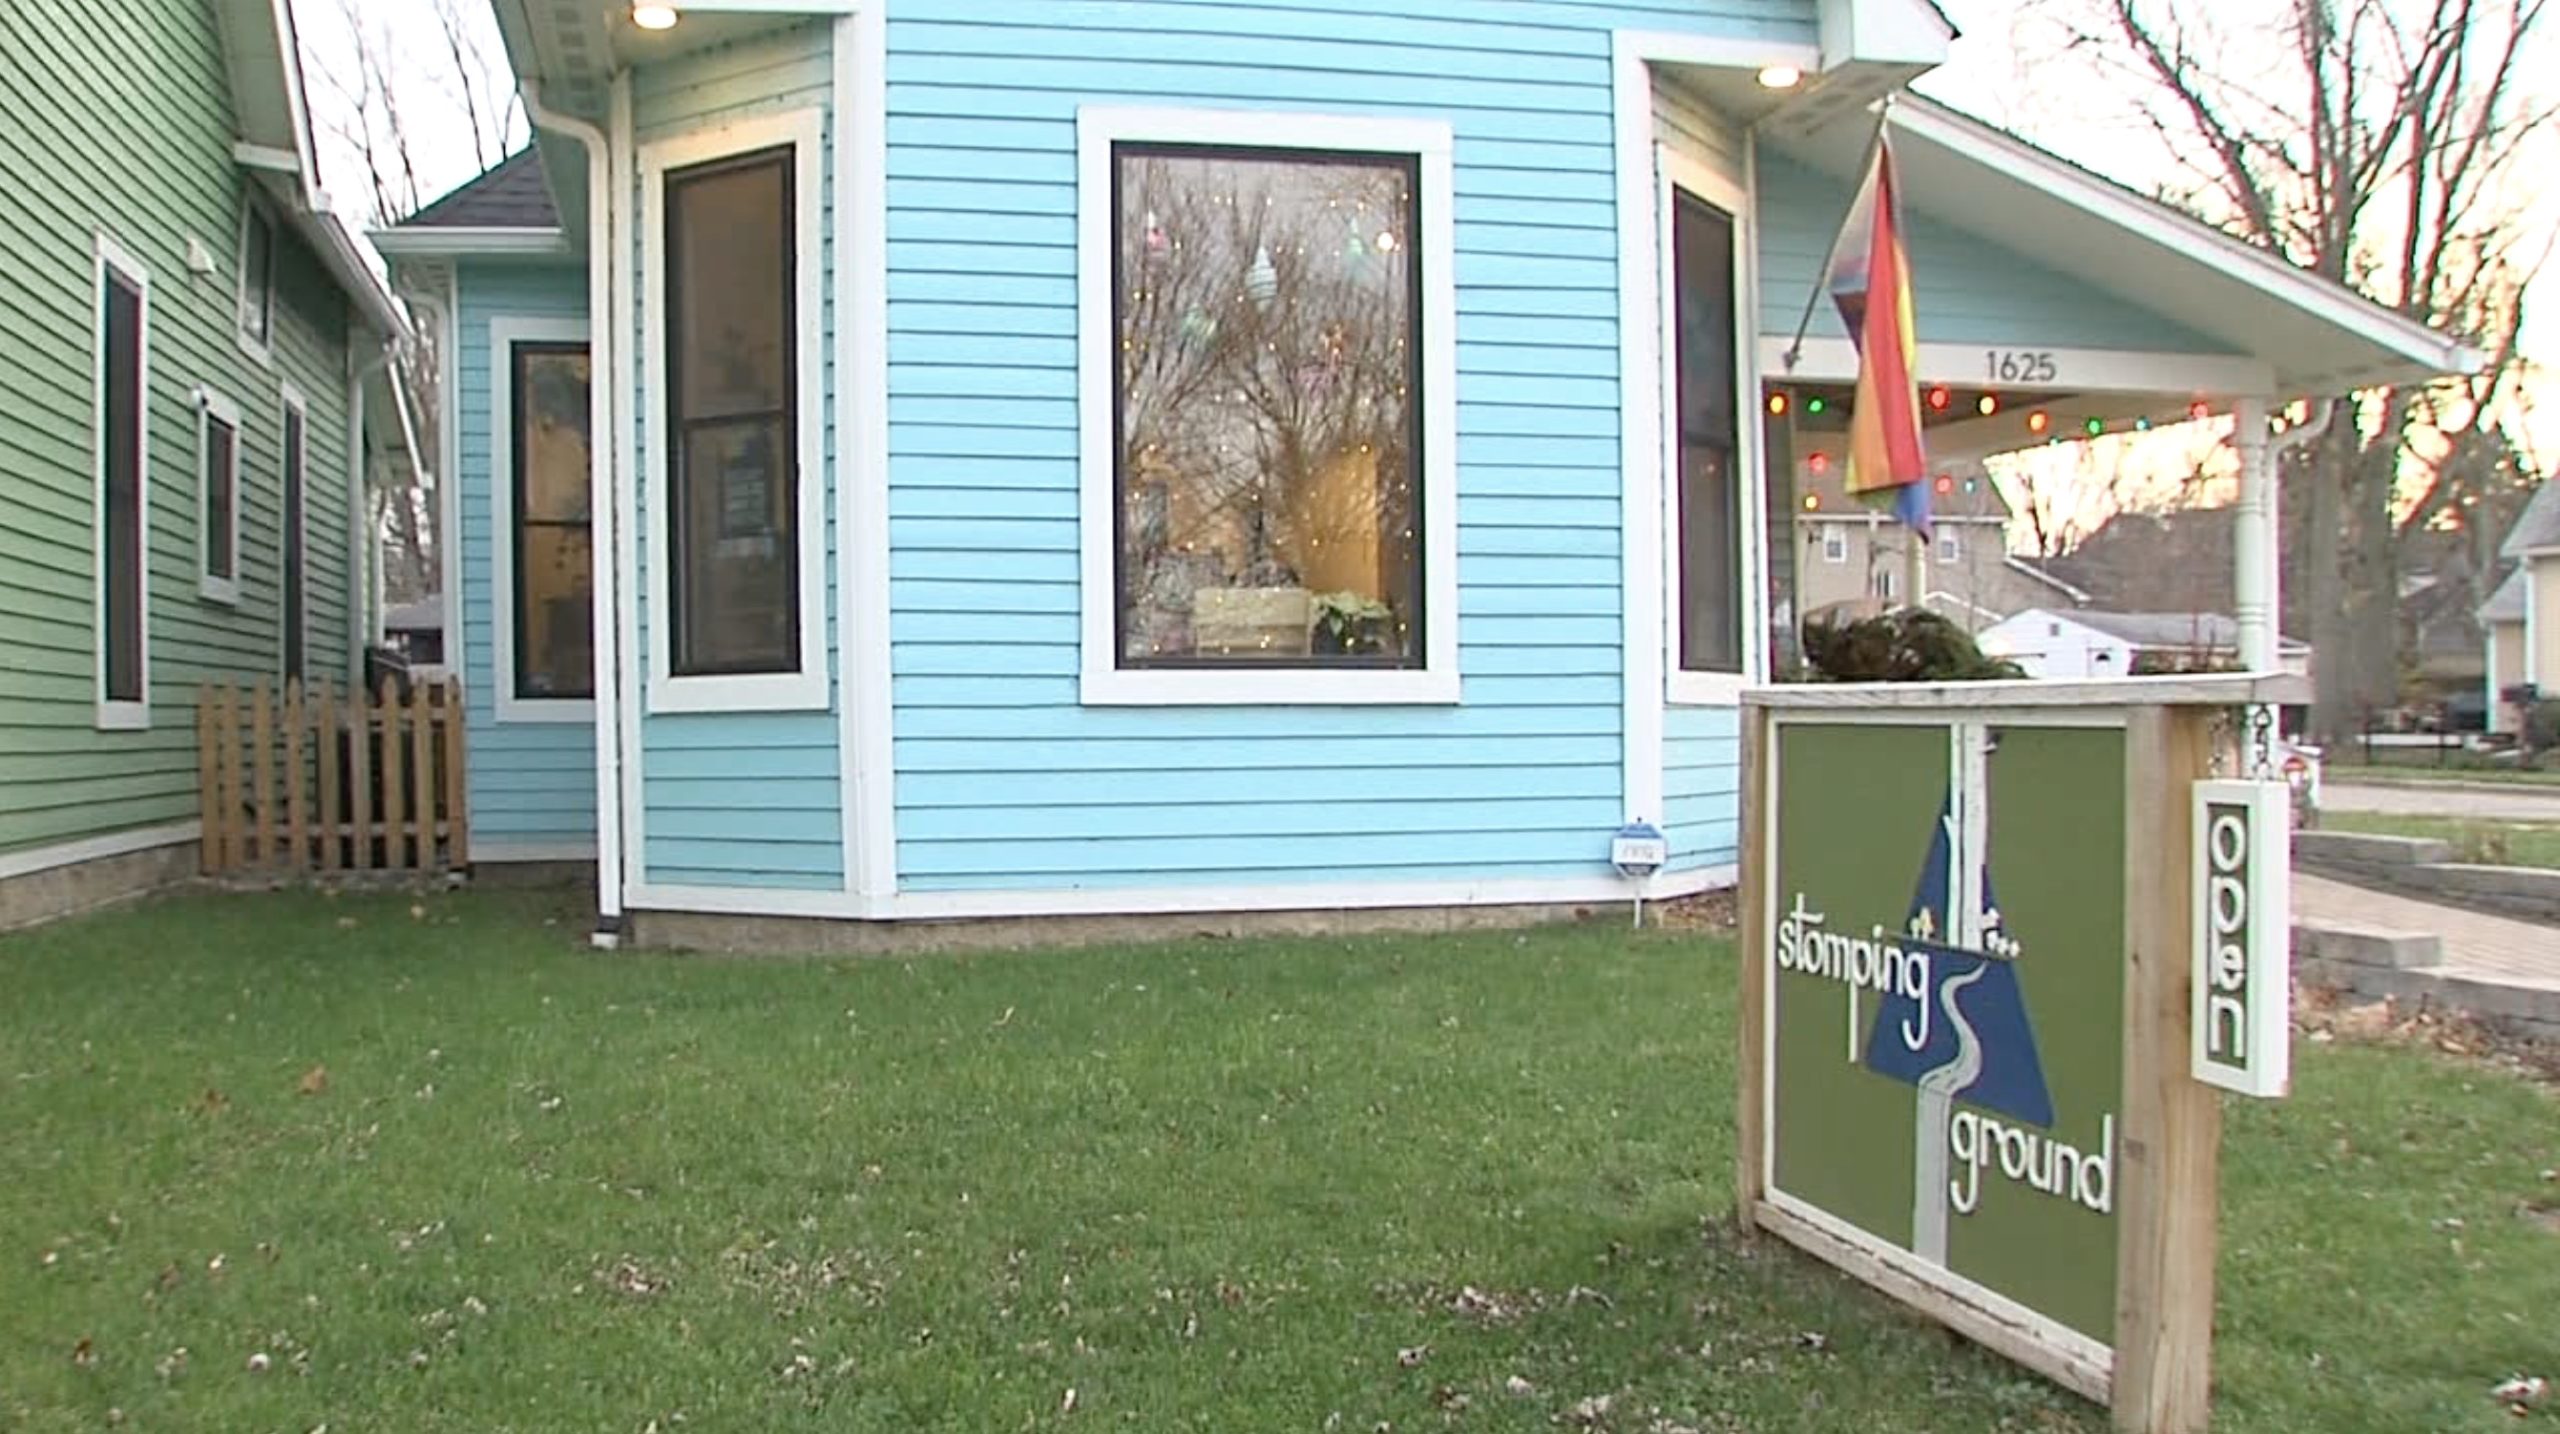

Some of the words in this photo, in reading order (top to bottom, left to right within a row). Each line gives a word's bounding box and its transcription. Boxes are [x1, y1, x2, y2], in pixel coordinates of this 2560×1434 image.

[1987, 351, 2056, 381] 1625
[1778, 892, 1930, 1063] stomping
[2210, 815, 2246, 1058] open
[1950, 1111, 2113, 1213] ground
